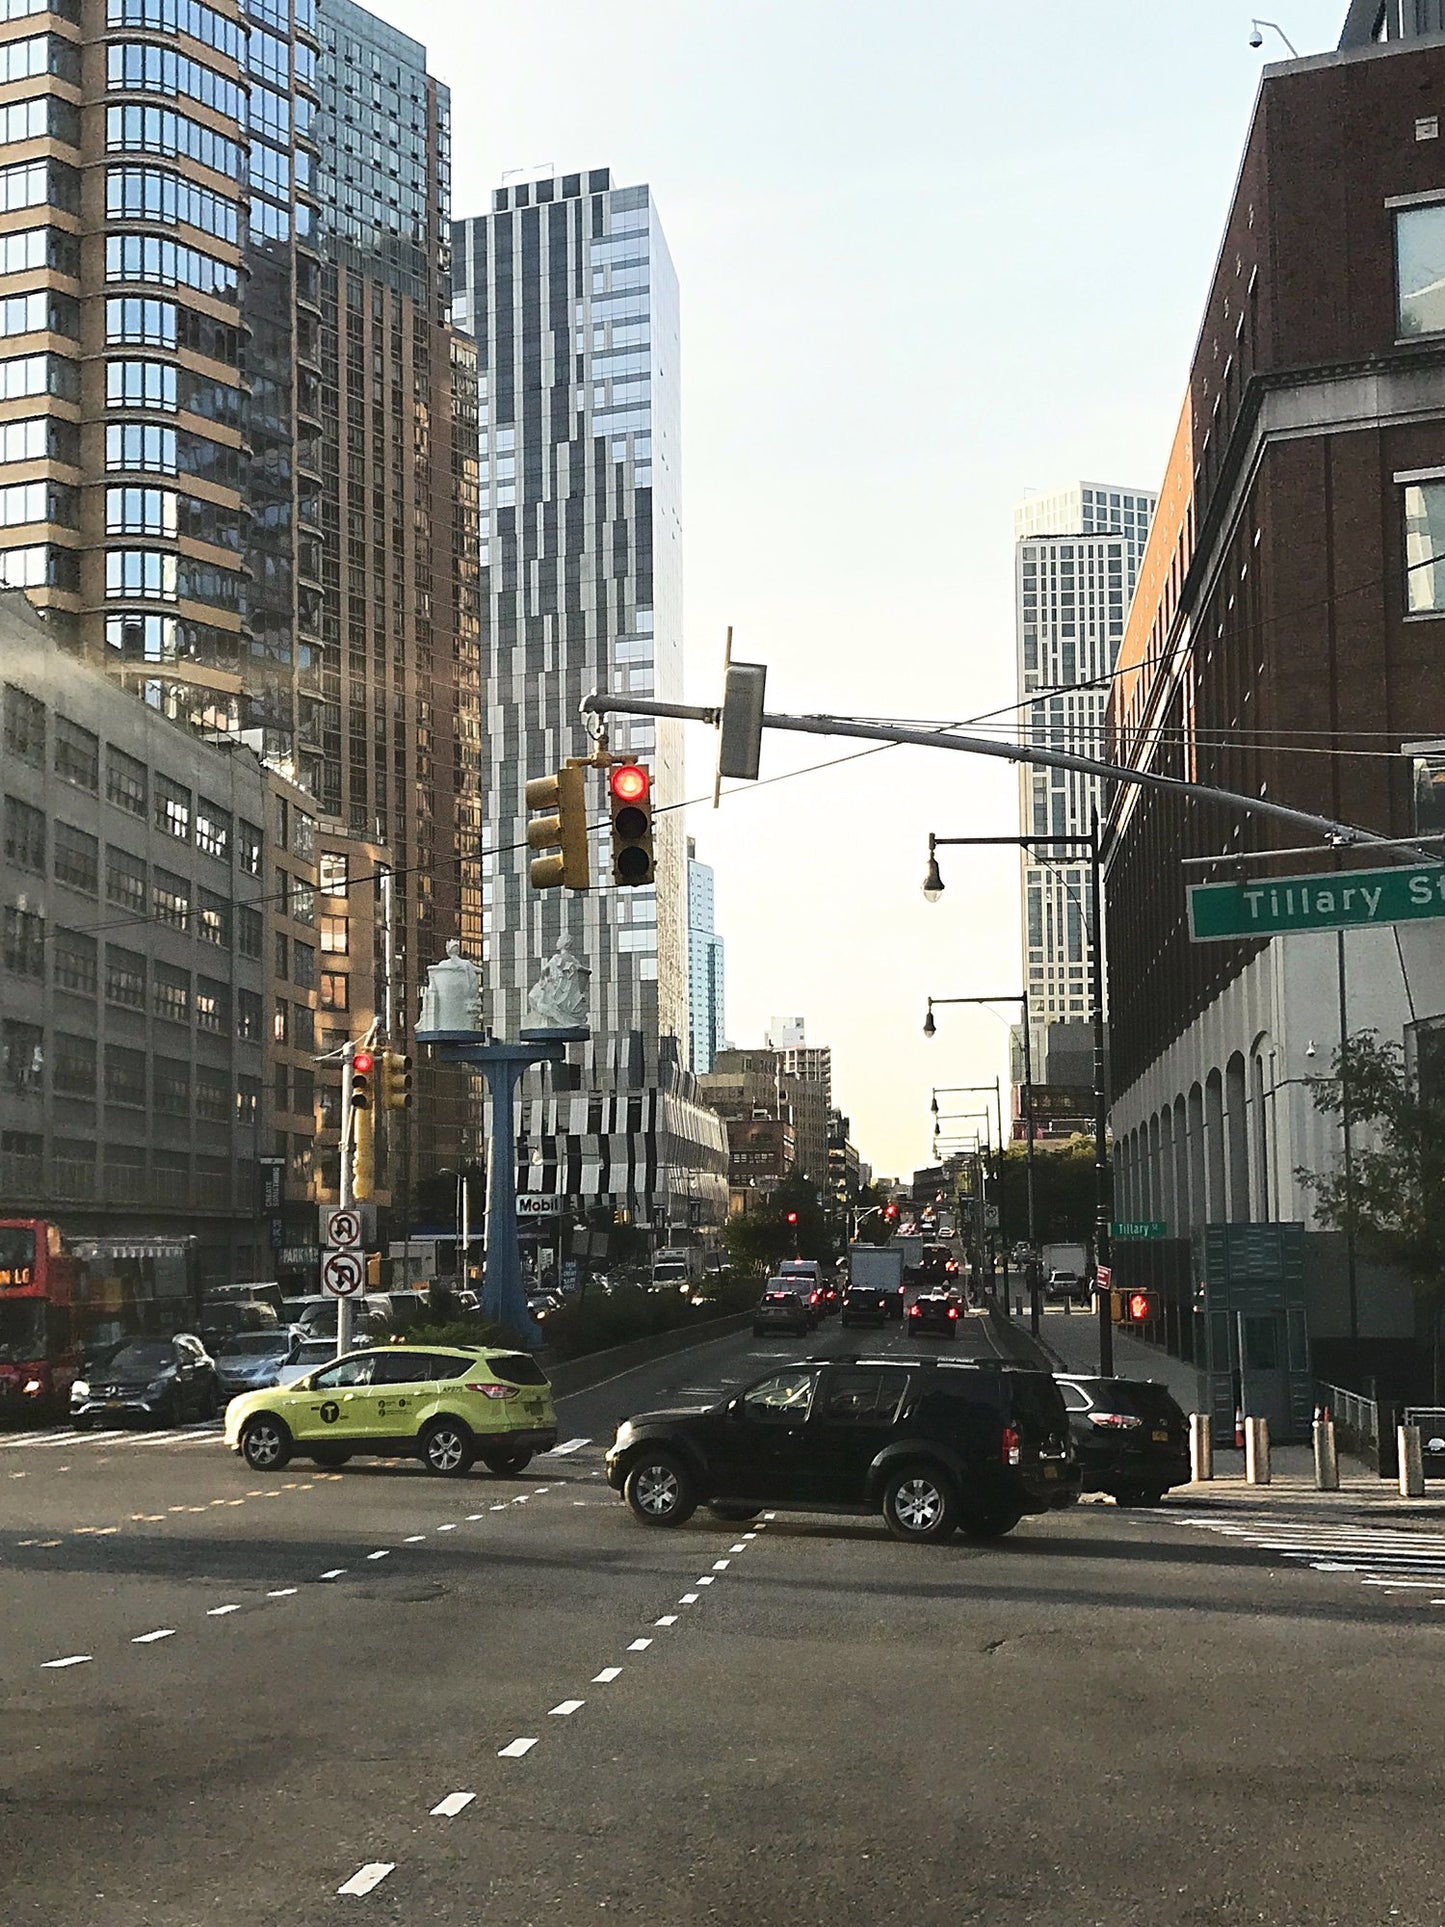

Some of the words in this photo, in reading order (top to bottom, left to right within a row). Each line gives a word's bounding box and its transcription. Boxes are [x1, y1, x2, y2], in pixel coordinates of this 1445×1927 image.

[1243, 887, 1381, 918] Tillary
[520, 1199, 558, 1211] Mobil
[1119, 1223, 1149, 1237] Tillary
